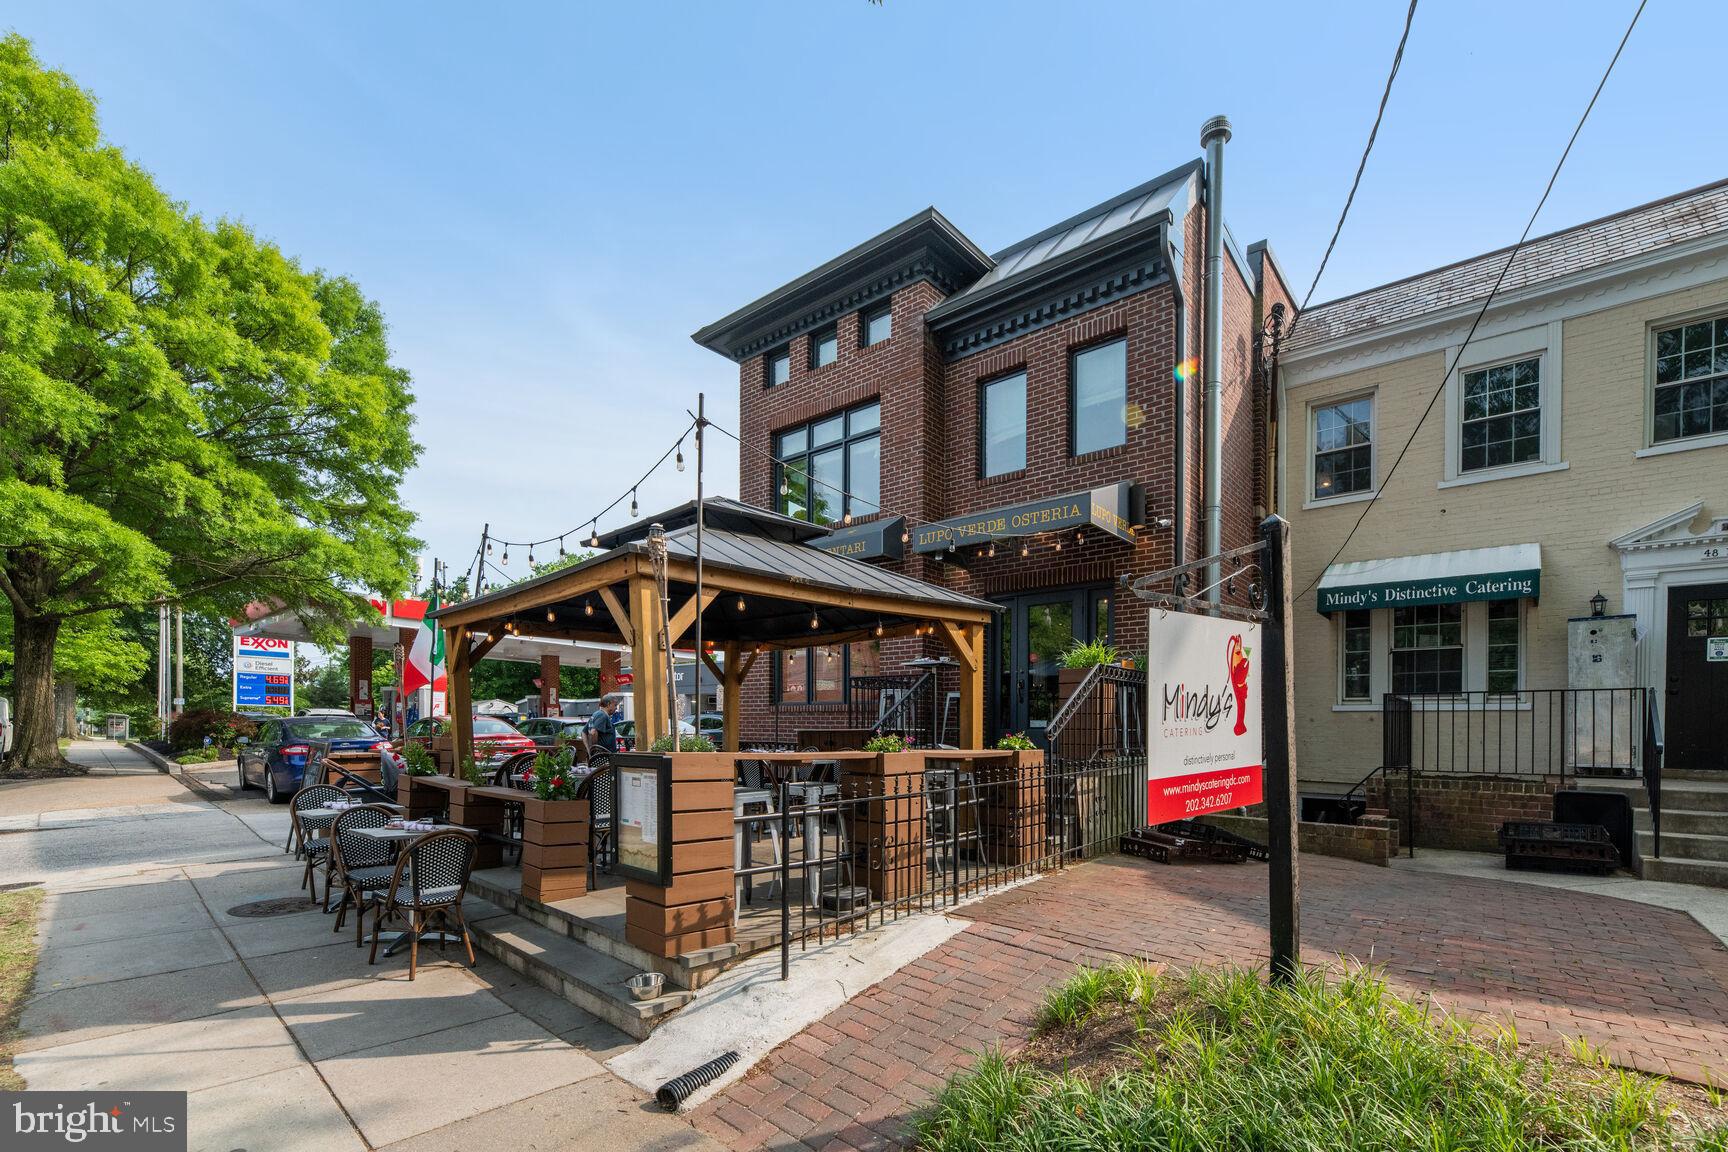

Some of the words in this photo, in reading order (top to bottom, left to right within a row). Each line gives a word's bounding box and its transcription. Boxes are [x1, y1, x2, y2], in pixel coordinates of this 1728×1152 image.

[919, 528, 953, 545] LUPO
[959, 518, 1006, 538] VERDE
[1011, 504, 1082, 527] OSTERIA
[1326, 590, 1378, 606] Mindy's
[1385, 584, 1457, 601] Distinctive
[1465, 578, 1532, 595] Catering
[240, 636, 288, 650] EXXON
[1162, 683, 1233, 731] Mindy's
[1163, 727, 1203, 738] CATERING
[1183, 752, 1214, 766] distinctively
[1215, 749, 1236, 763] personal
[1163, 773, 1251, 797] www.mindyscateringdc.com
[1185, 792, 1233, 813] 202.342.6207
